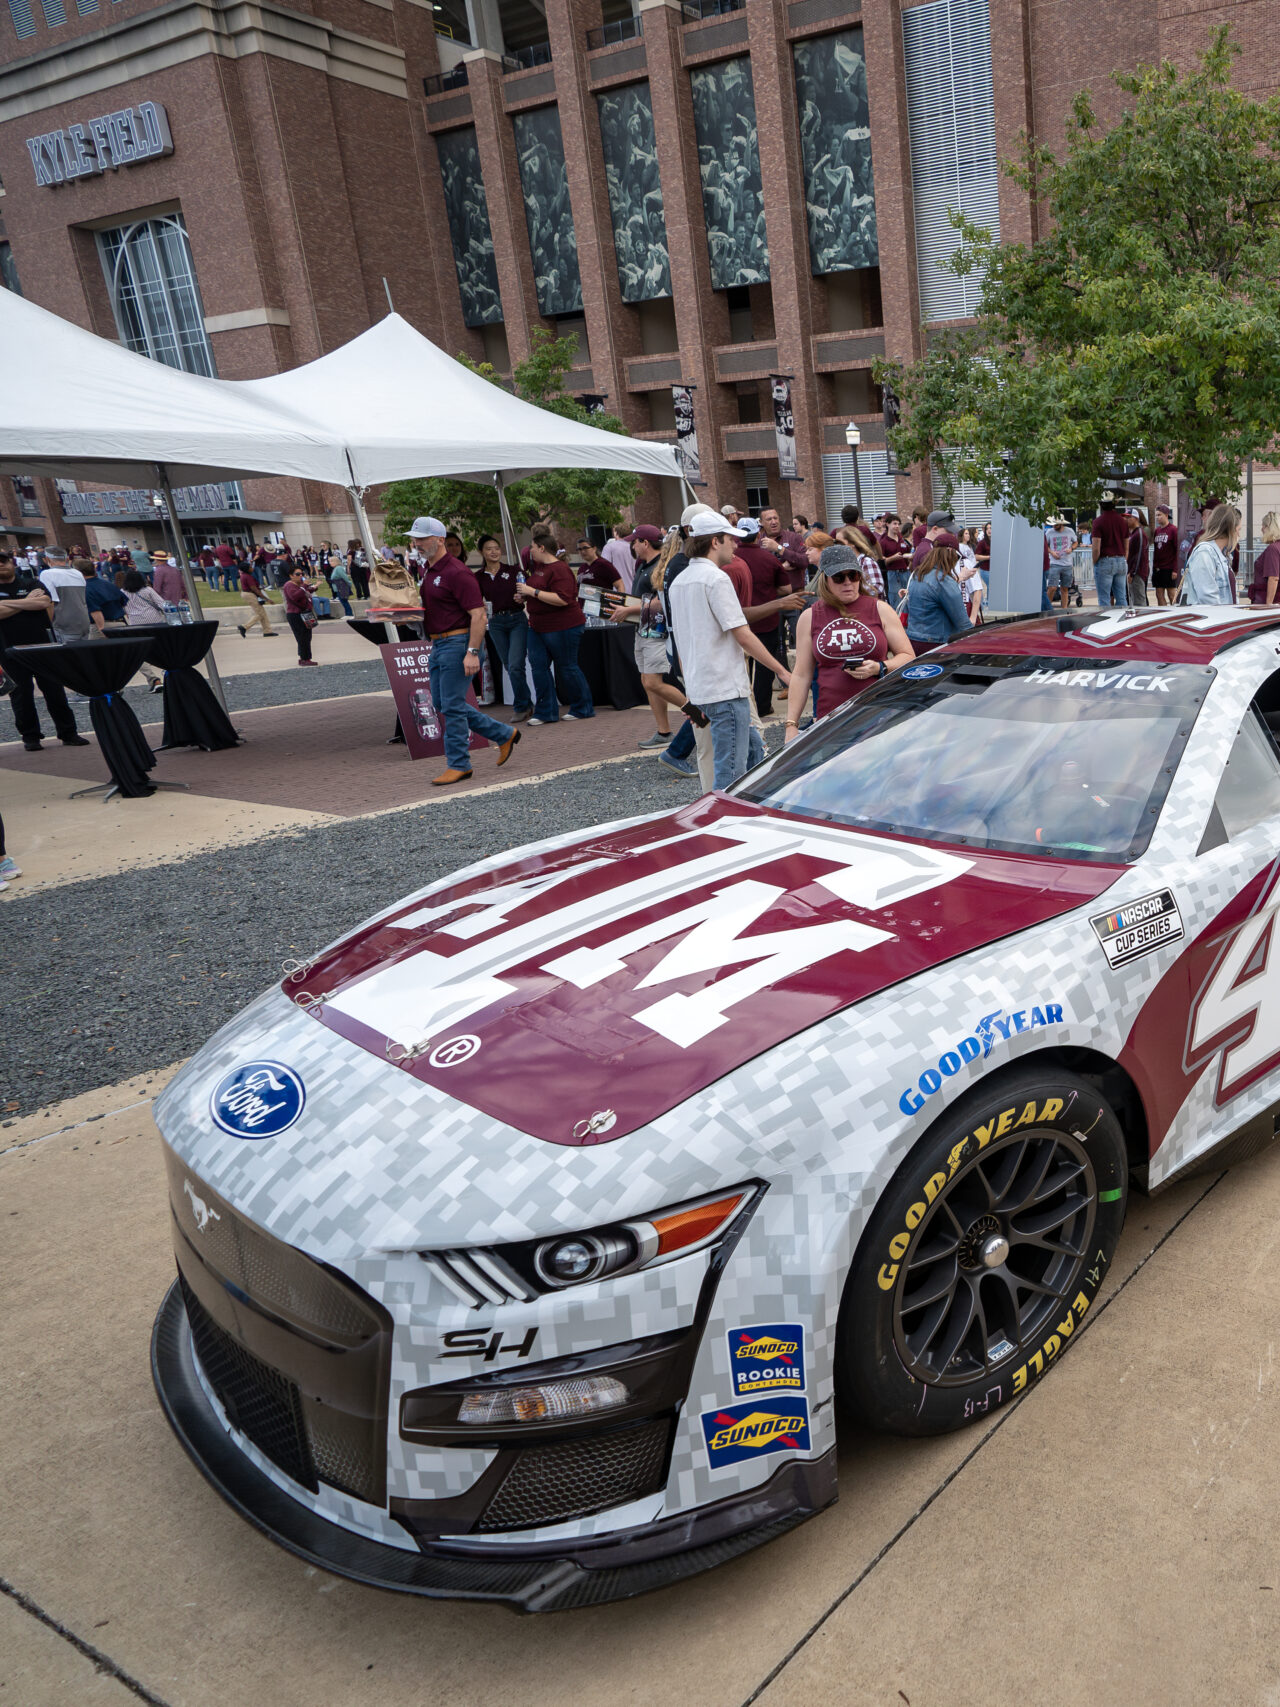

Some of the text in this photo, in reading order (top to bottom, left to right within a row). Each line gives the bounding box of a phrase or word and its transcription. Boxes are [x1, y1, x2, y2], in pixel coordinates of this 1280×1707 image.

[26, 101, 164, 186] KYLE FIELD
[61, 492, 101, 516] HOME
[394, 656, 415, 668] TAG
[1023, 669, 1177, 692] HARVICK
[1121, 897, 1164, 927] NASCAR
[1115, 917, 1171, 953] CUP SERIES
[738, 1342, 797, 1358] SUNOCO
[1012, 1291, 1090, 1395] EAGLE
[737, 1367, 801, 1384] ROOKIE
[741, 1379, 799, 1390] CONTENDER
[715, 1417, 802, 1448] SUNOCO
